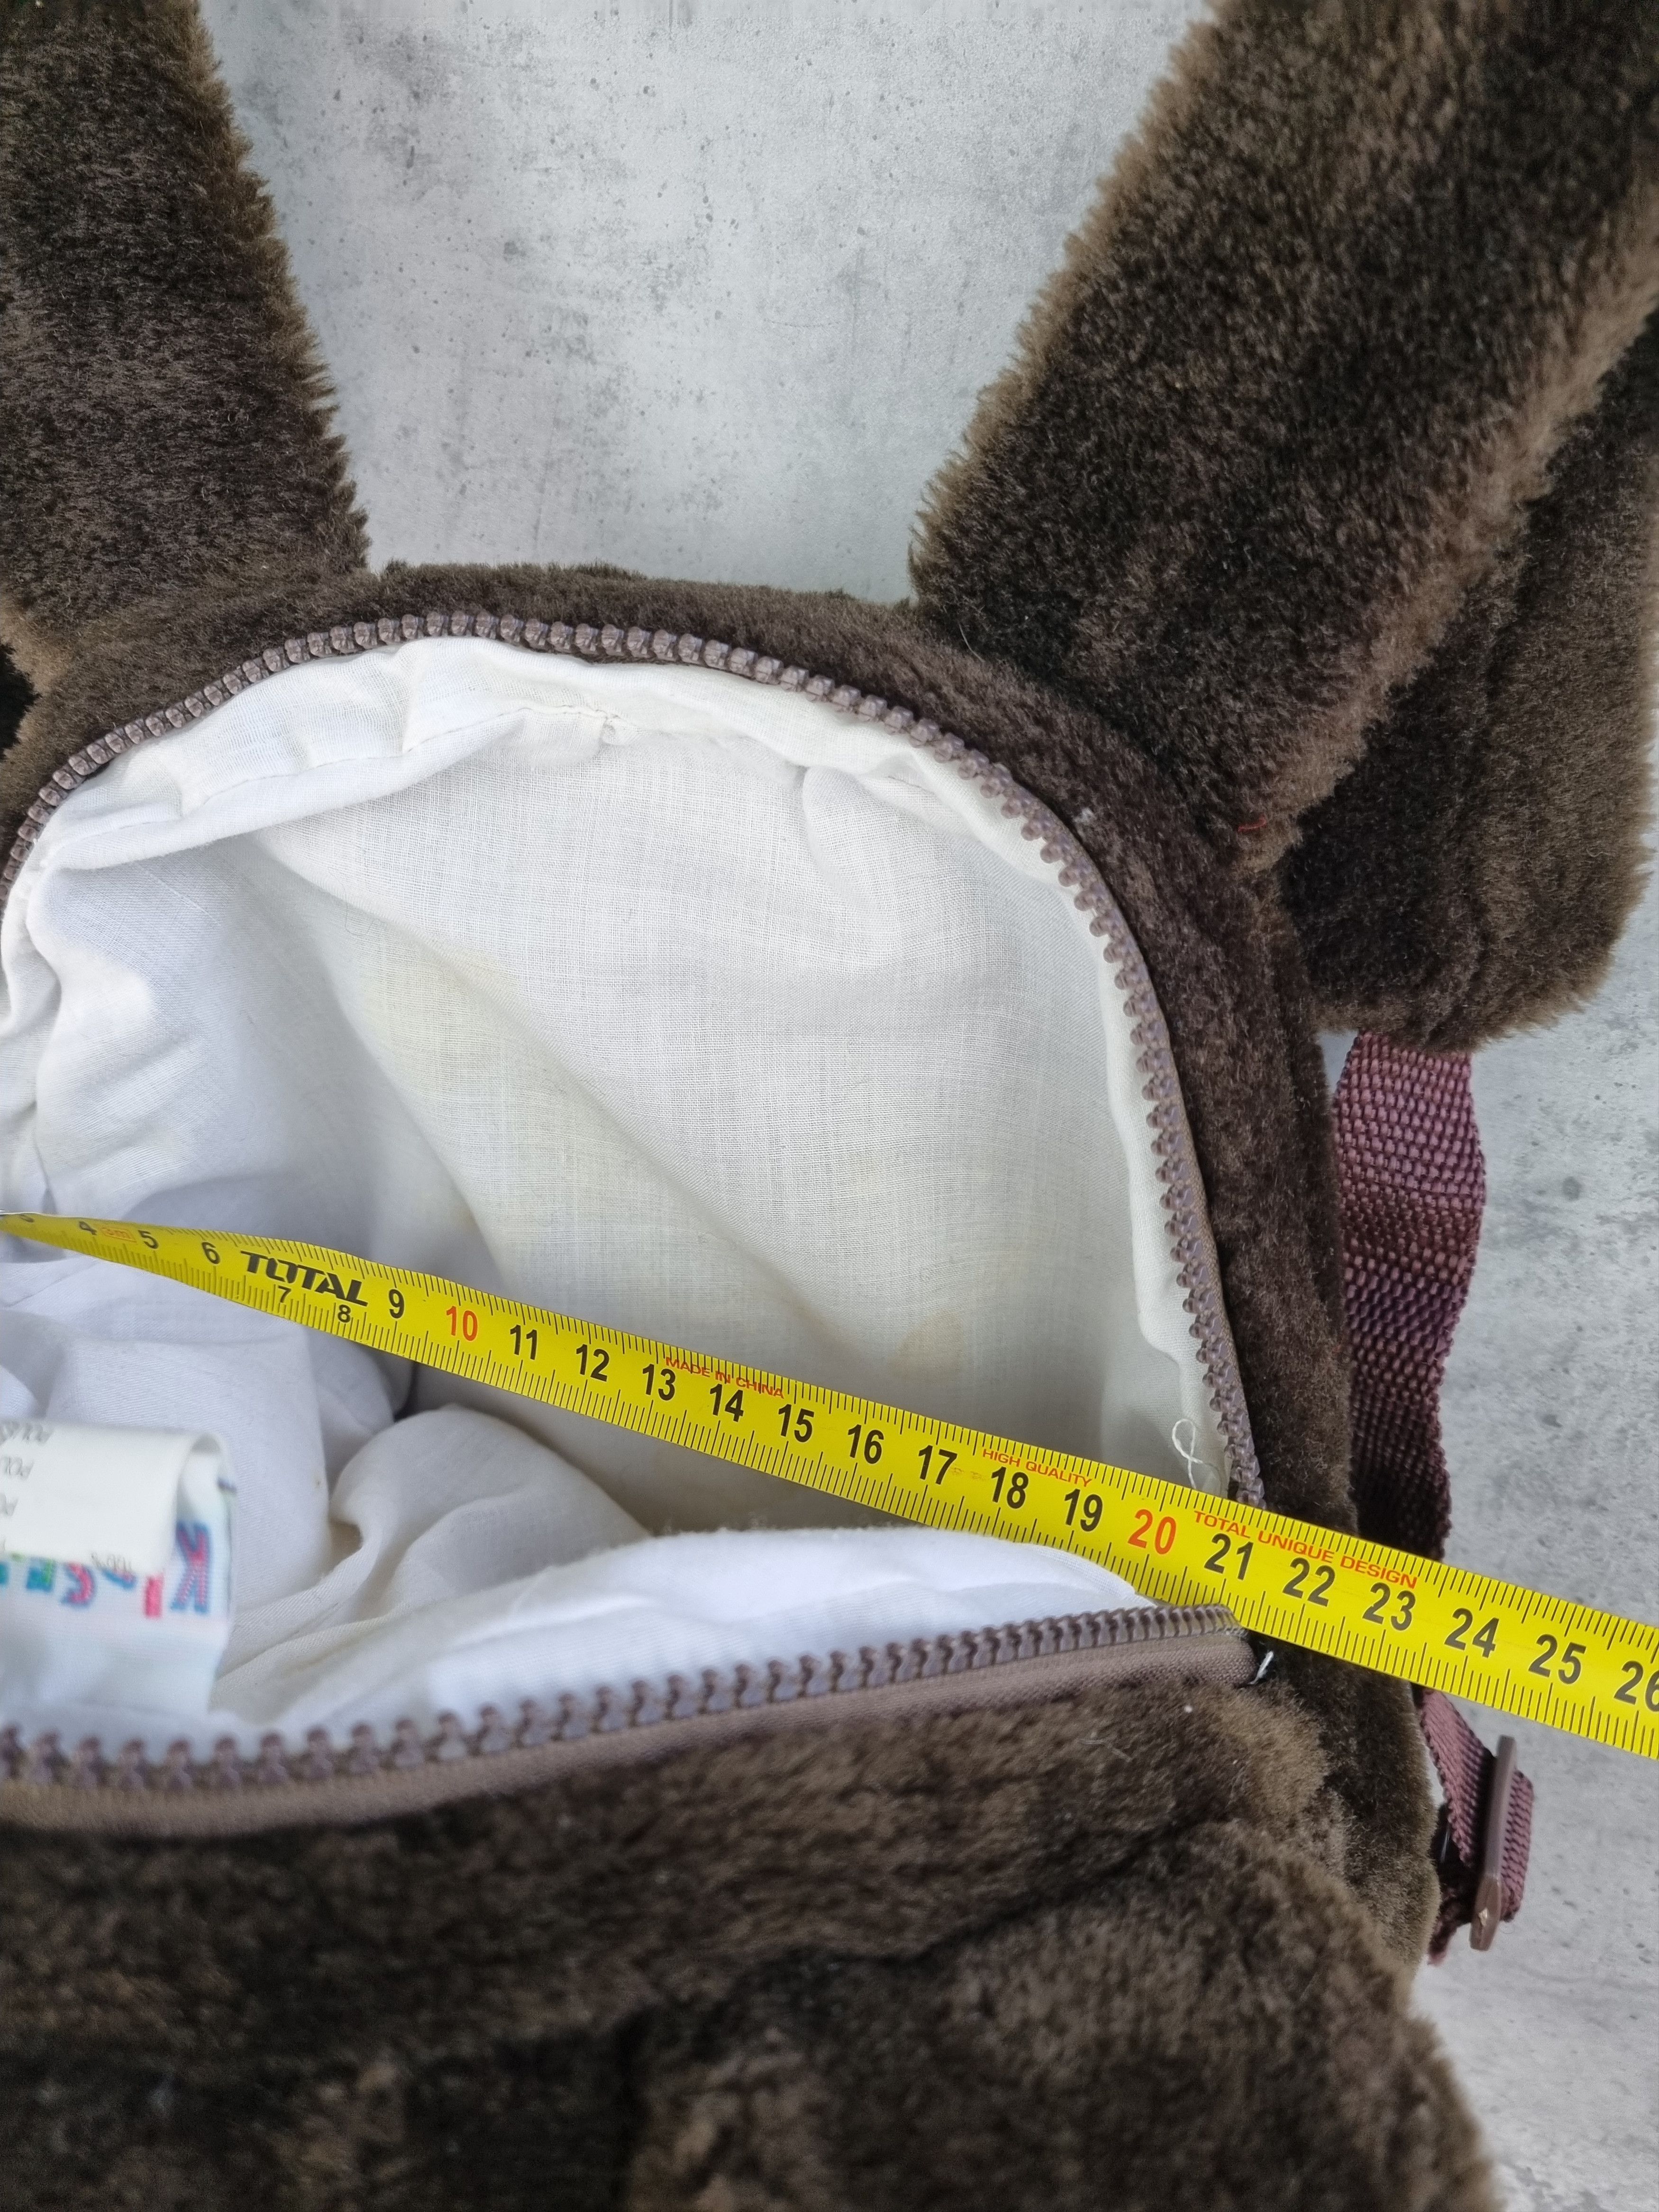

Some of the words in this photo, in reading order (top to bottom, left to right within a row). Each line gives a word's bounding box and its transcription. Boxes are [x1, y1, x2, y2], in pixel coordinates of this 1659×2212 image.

[240, 1250, 368, 1307] TOTAL
[665, 1356, 711, 1378] MADE
[715, 1370, 733, 1384] IN
[735, 1376, 785, 1399] CHINA
[138, 1230, 159, 1249] 5
[201, 1241, 220, 1264] 6
[277, 1285, 292, 1303] 7
[337, 1304, 352, 1323] 8
[389, 1289, 405, 1319] 9
[446, 1305, 478, 1341] 10
[510, 1324, 538, 1360] 11
[575, 1344, 610, 1383] 12
[642, 1363, 676, 1401] 13
[709, 1383, 745, 1422] 14
[777, 1403, 815, 1443] 15
[847, 1424, 884, 1465] 16
[918, 1444, 958, 1485] 17
[991, 1466, 1029, 1509] 18
[1063, 1488, 1103, 1532] 19
[1127, 1509, 1176, 1555] 20
[1204, 1532, 1254, 1581] 21
[1282, 1557, 1336, 1607] 22
[1362, 1582, 1416, 1631] 23
[1444, 1607, 1500, 1658] 24
[1528, 1634, 1587, 1685] 25
[982, 1448, 1021, 1467] HIGH
[1025, 1460, 1093, 1488] QUALITY
[1194, 1511, 1250, 1538] TOTAL
[1258, 1530, 1335, 1563] UNIQUE
[1340, 1555, 1418, 1590] DESIGN
